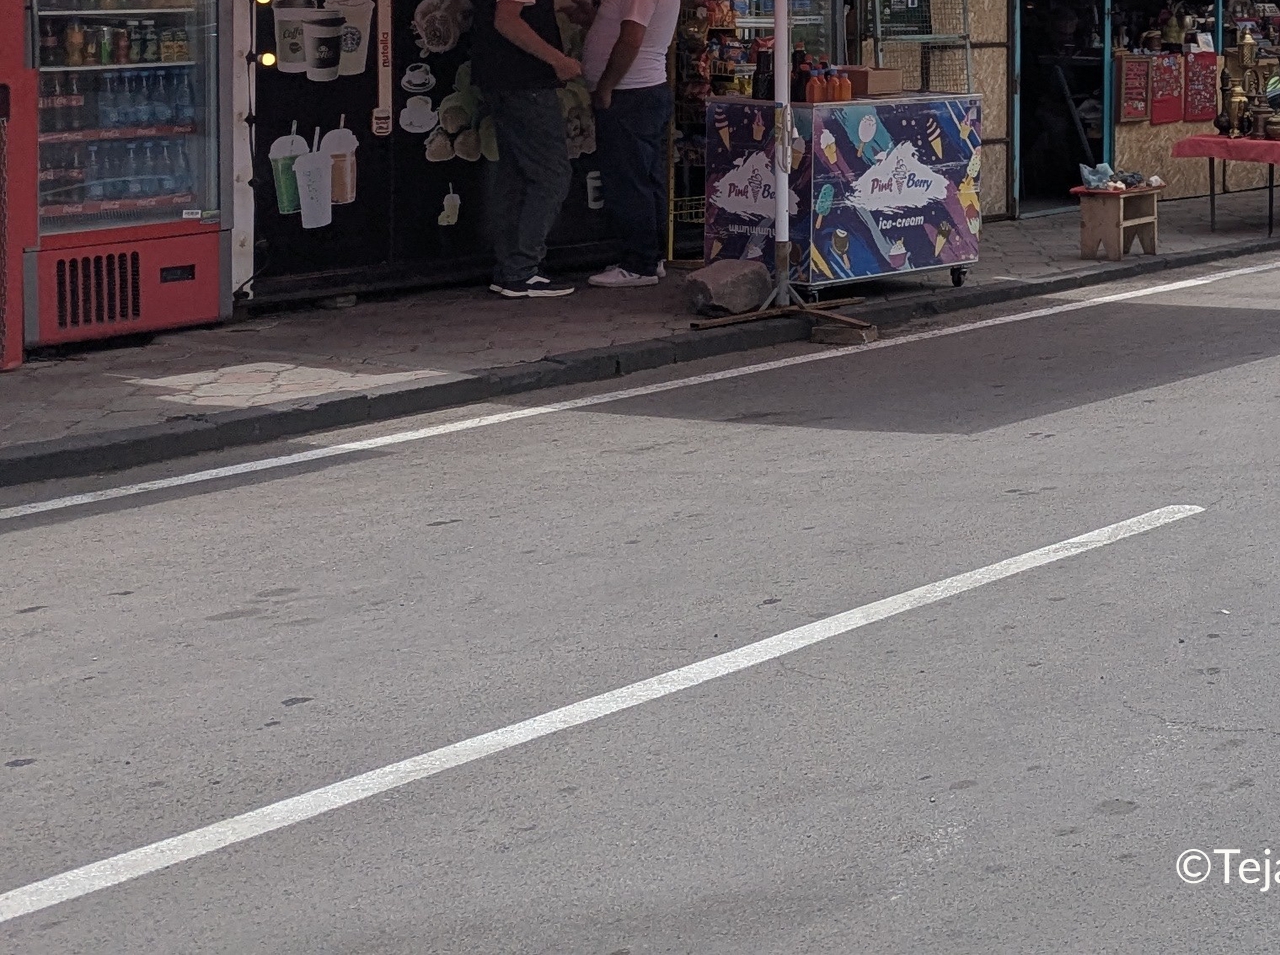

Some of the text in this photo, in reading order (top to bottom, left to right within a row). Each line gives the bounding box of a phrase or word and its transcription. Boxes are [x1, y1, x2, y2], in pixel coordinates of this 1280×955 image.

[728, 182, 749, 198] Pink
[871, 174, 933, 194] Pink Berry
[878, 215, 925, 231] ice-cream
